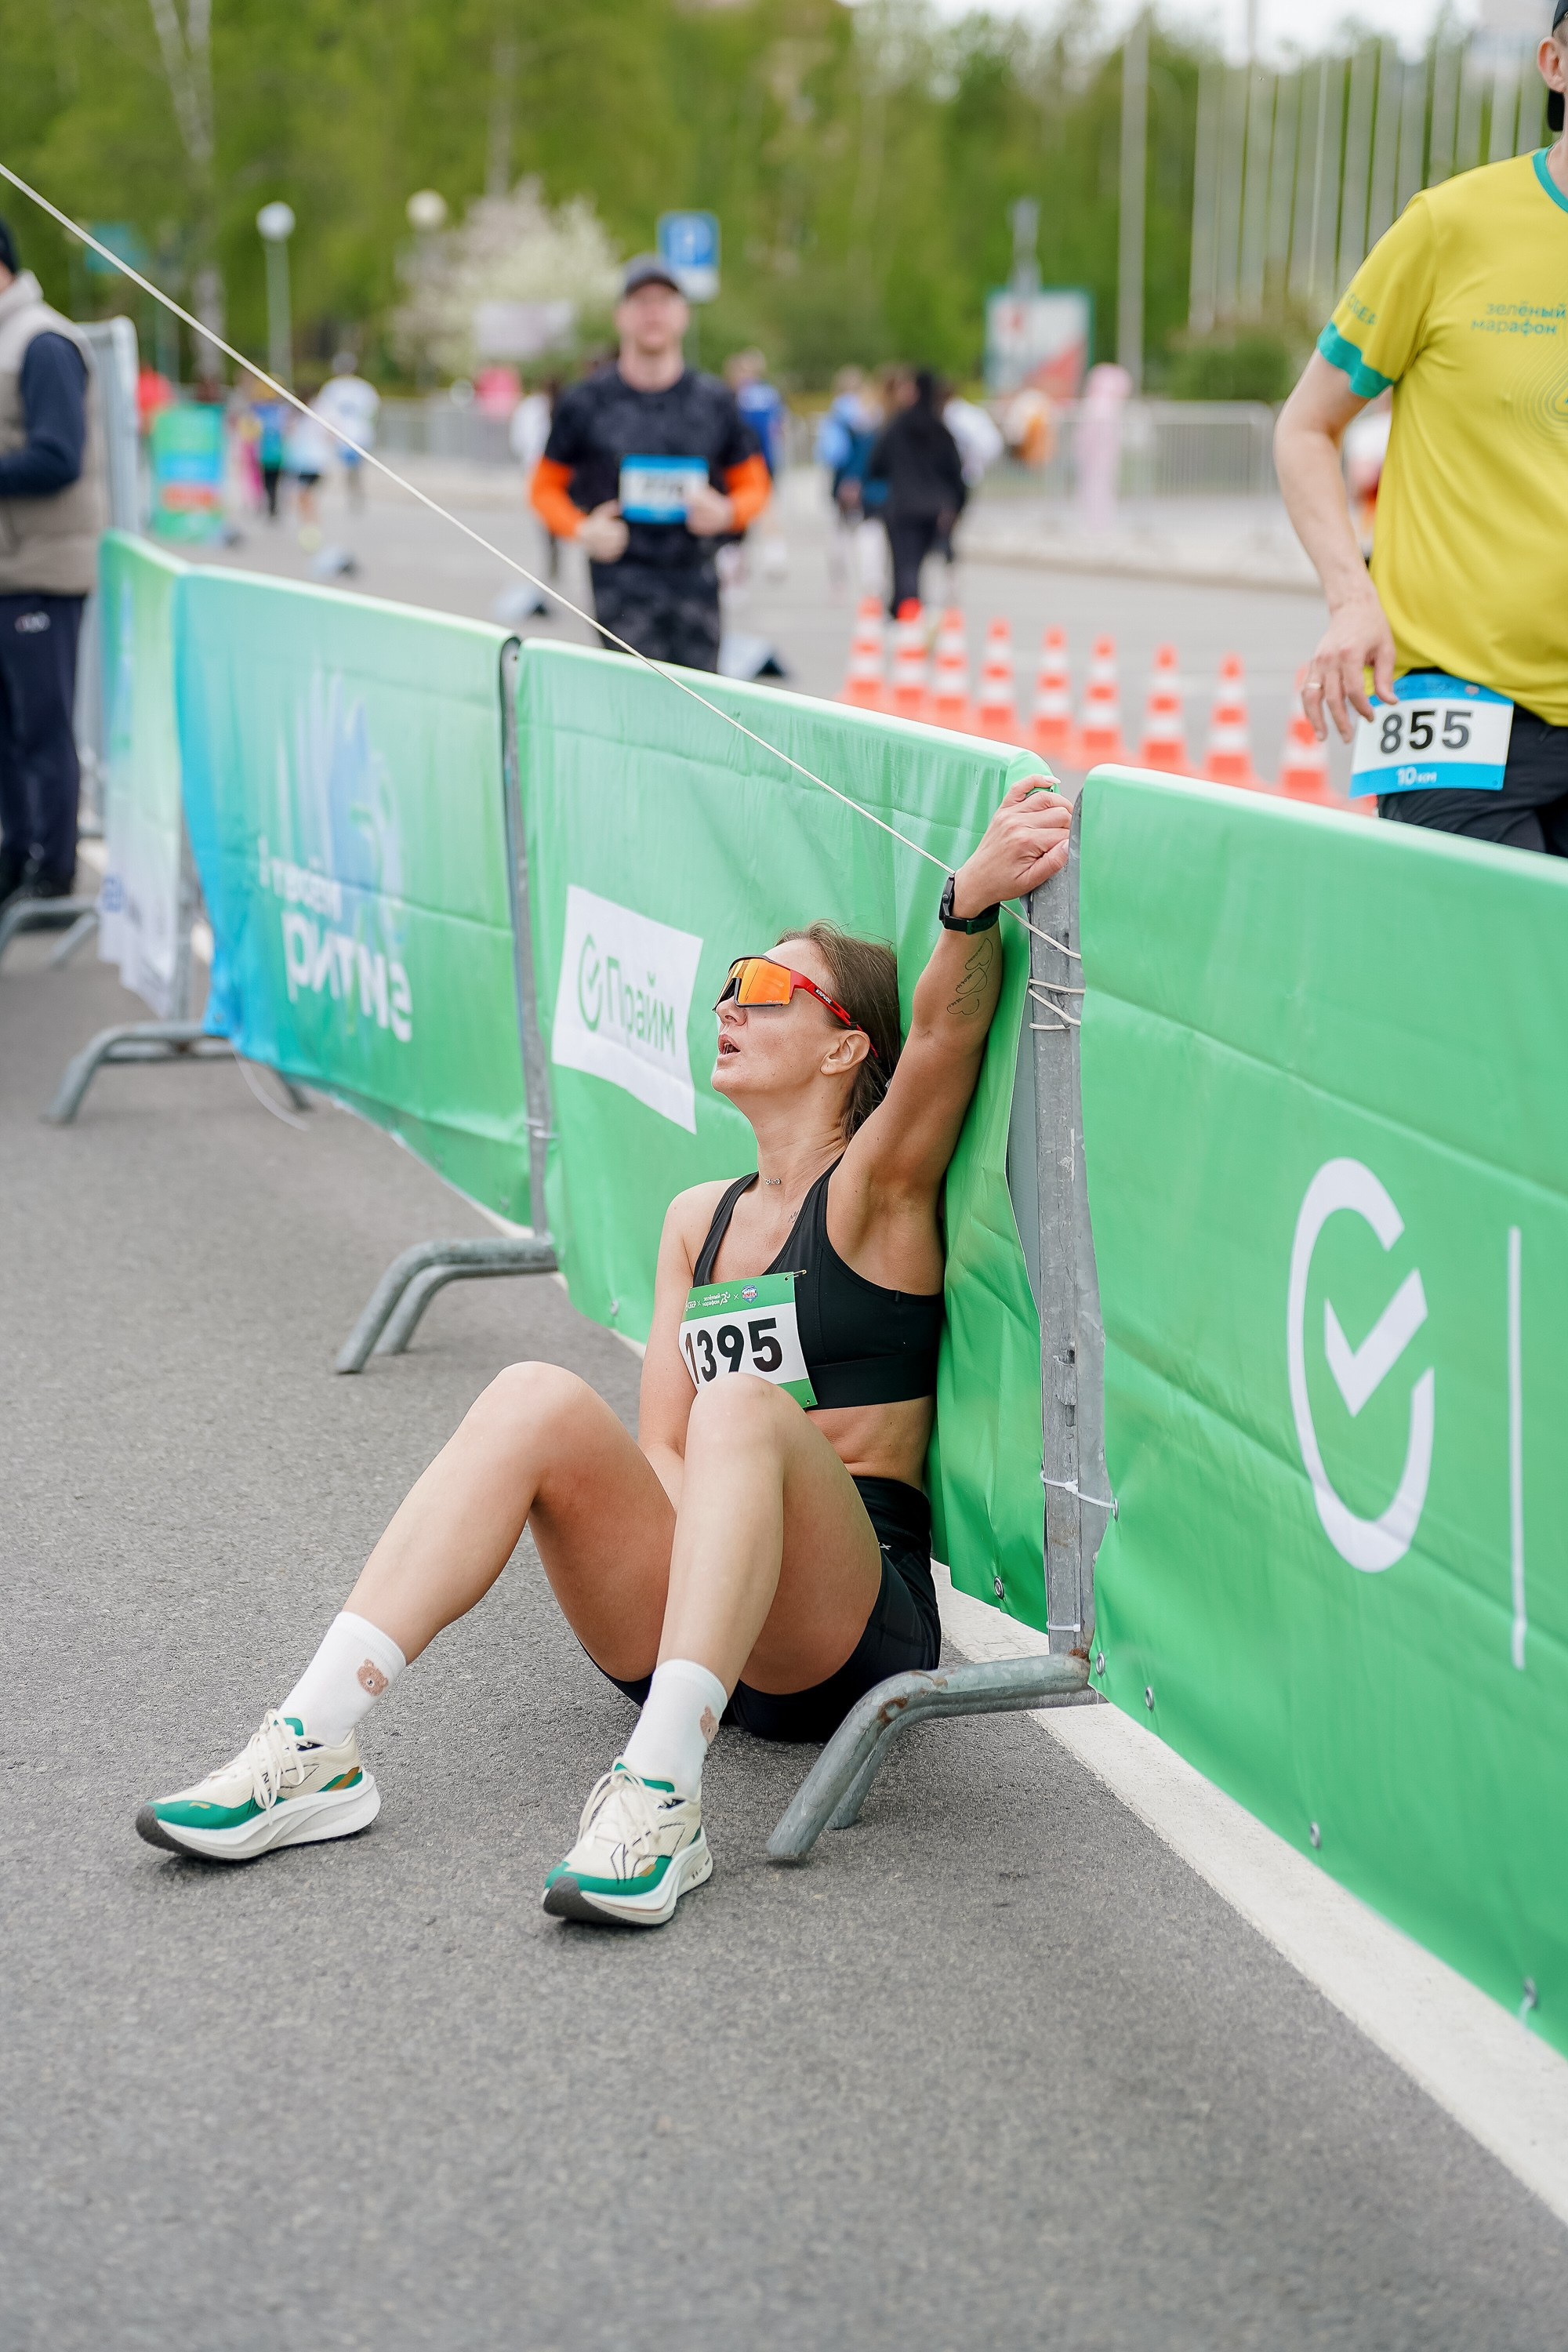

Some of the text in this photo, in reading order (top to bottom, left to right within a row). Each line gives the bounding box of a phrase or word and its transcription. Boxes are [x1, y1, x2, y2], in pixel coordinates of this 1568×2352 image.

[1470, 318, 1557, 336] марафон
[1486, 301, 1566, 318] зелёный
[1380, 710, 1472, 754] 855
[606, 955, 676, 1058] Прайм
[684, 1317, 783, 1385] 1395
